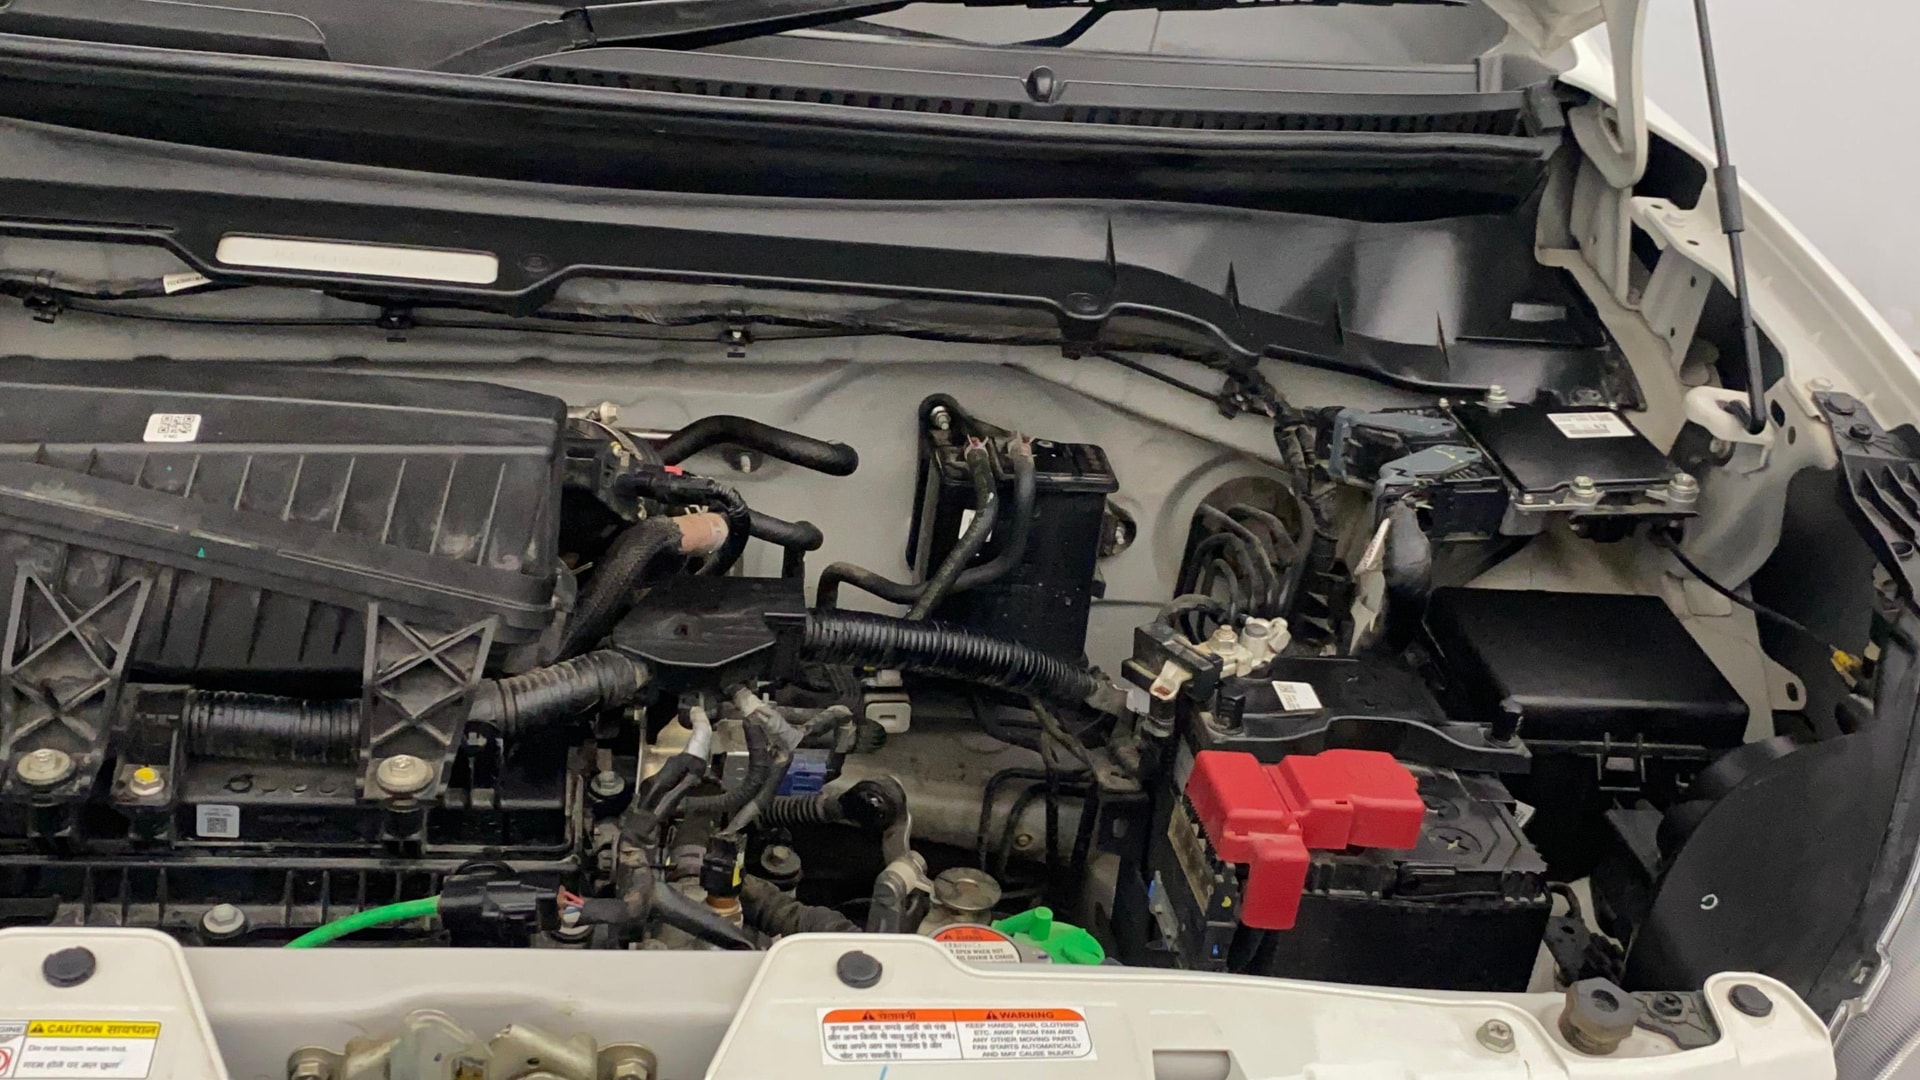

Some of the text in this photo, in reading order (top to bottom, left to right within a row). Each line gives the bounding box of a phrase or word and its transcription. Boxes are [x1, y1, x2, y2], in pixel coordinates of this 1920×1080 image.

[1000, 1011, 1054, 1019] WARNING
[47, 1025, 103, 1034] CAUTION
[28, 1044, 41, 1052] Do
